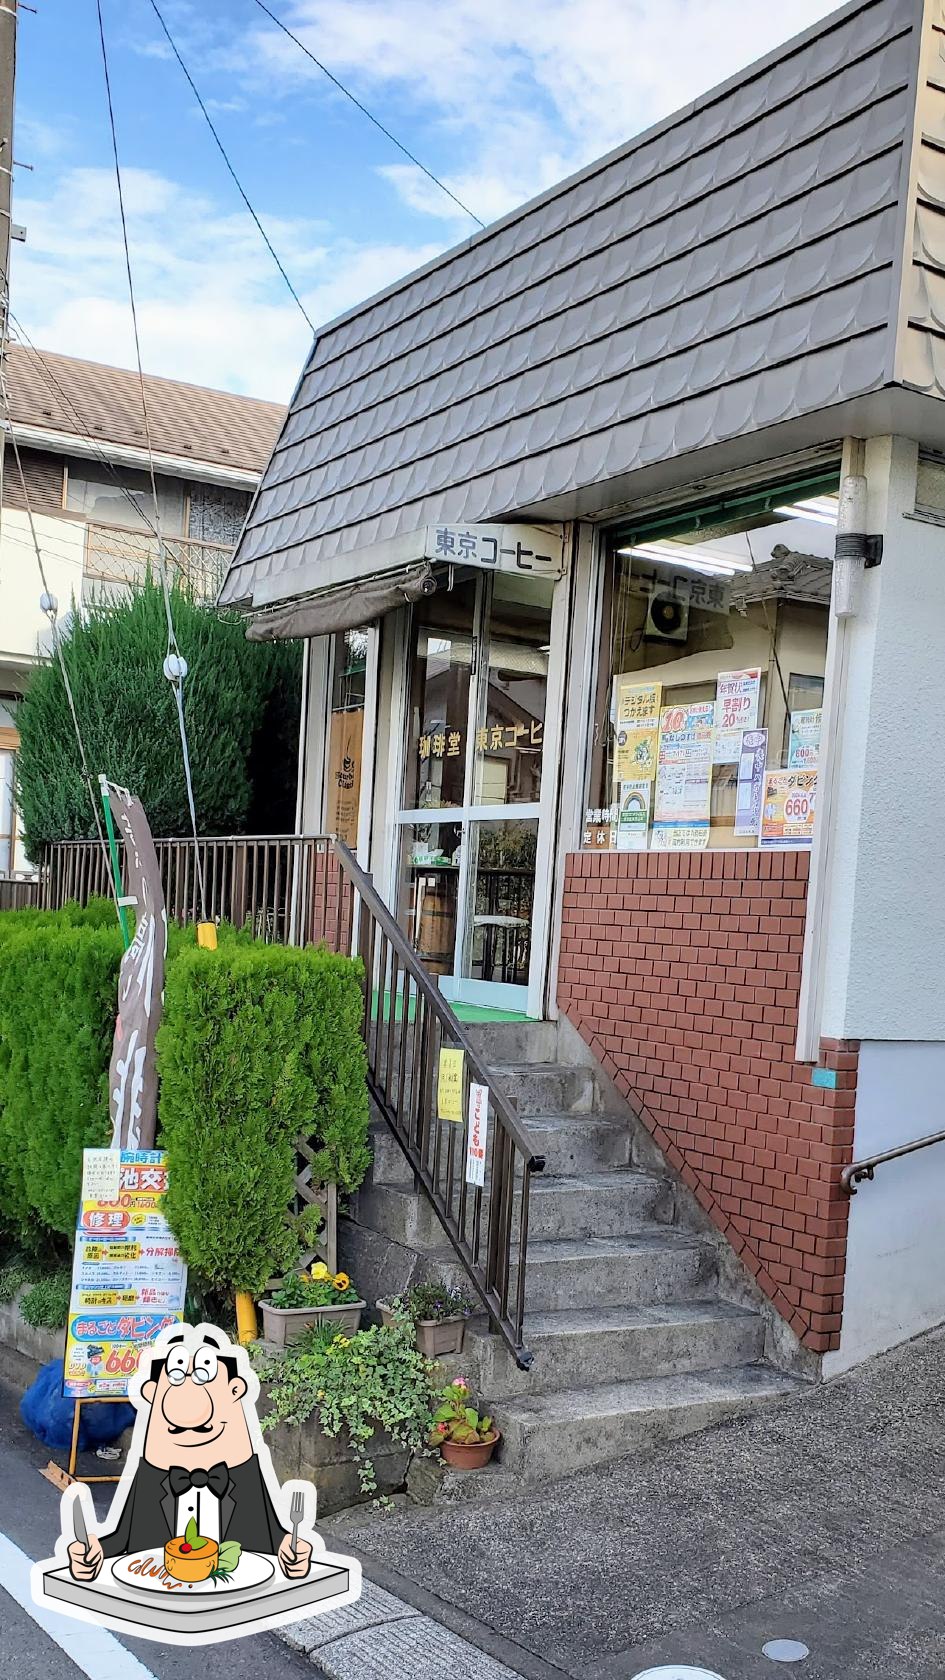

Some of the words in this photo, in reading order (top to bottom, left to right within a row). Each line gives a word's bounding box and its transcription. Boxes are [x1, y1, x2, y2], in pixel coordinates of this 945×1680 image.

[435, 527, 552, 569] 東京コーヒー
[722, 697, 751, 713] 早割り
[785, 799, 808, 816] 660
[586, 808, 618, 824] 営業時間
[583, 830, 617, 844] 定休日
[120, 1151, 161, 1164] 腕時計
[119, 1167, 169, 1191] 池交
[89, 1212, 124, 1228] 修理
[105, 1349, 144, 1375] 66
